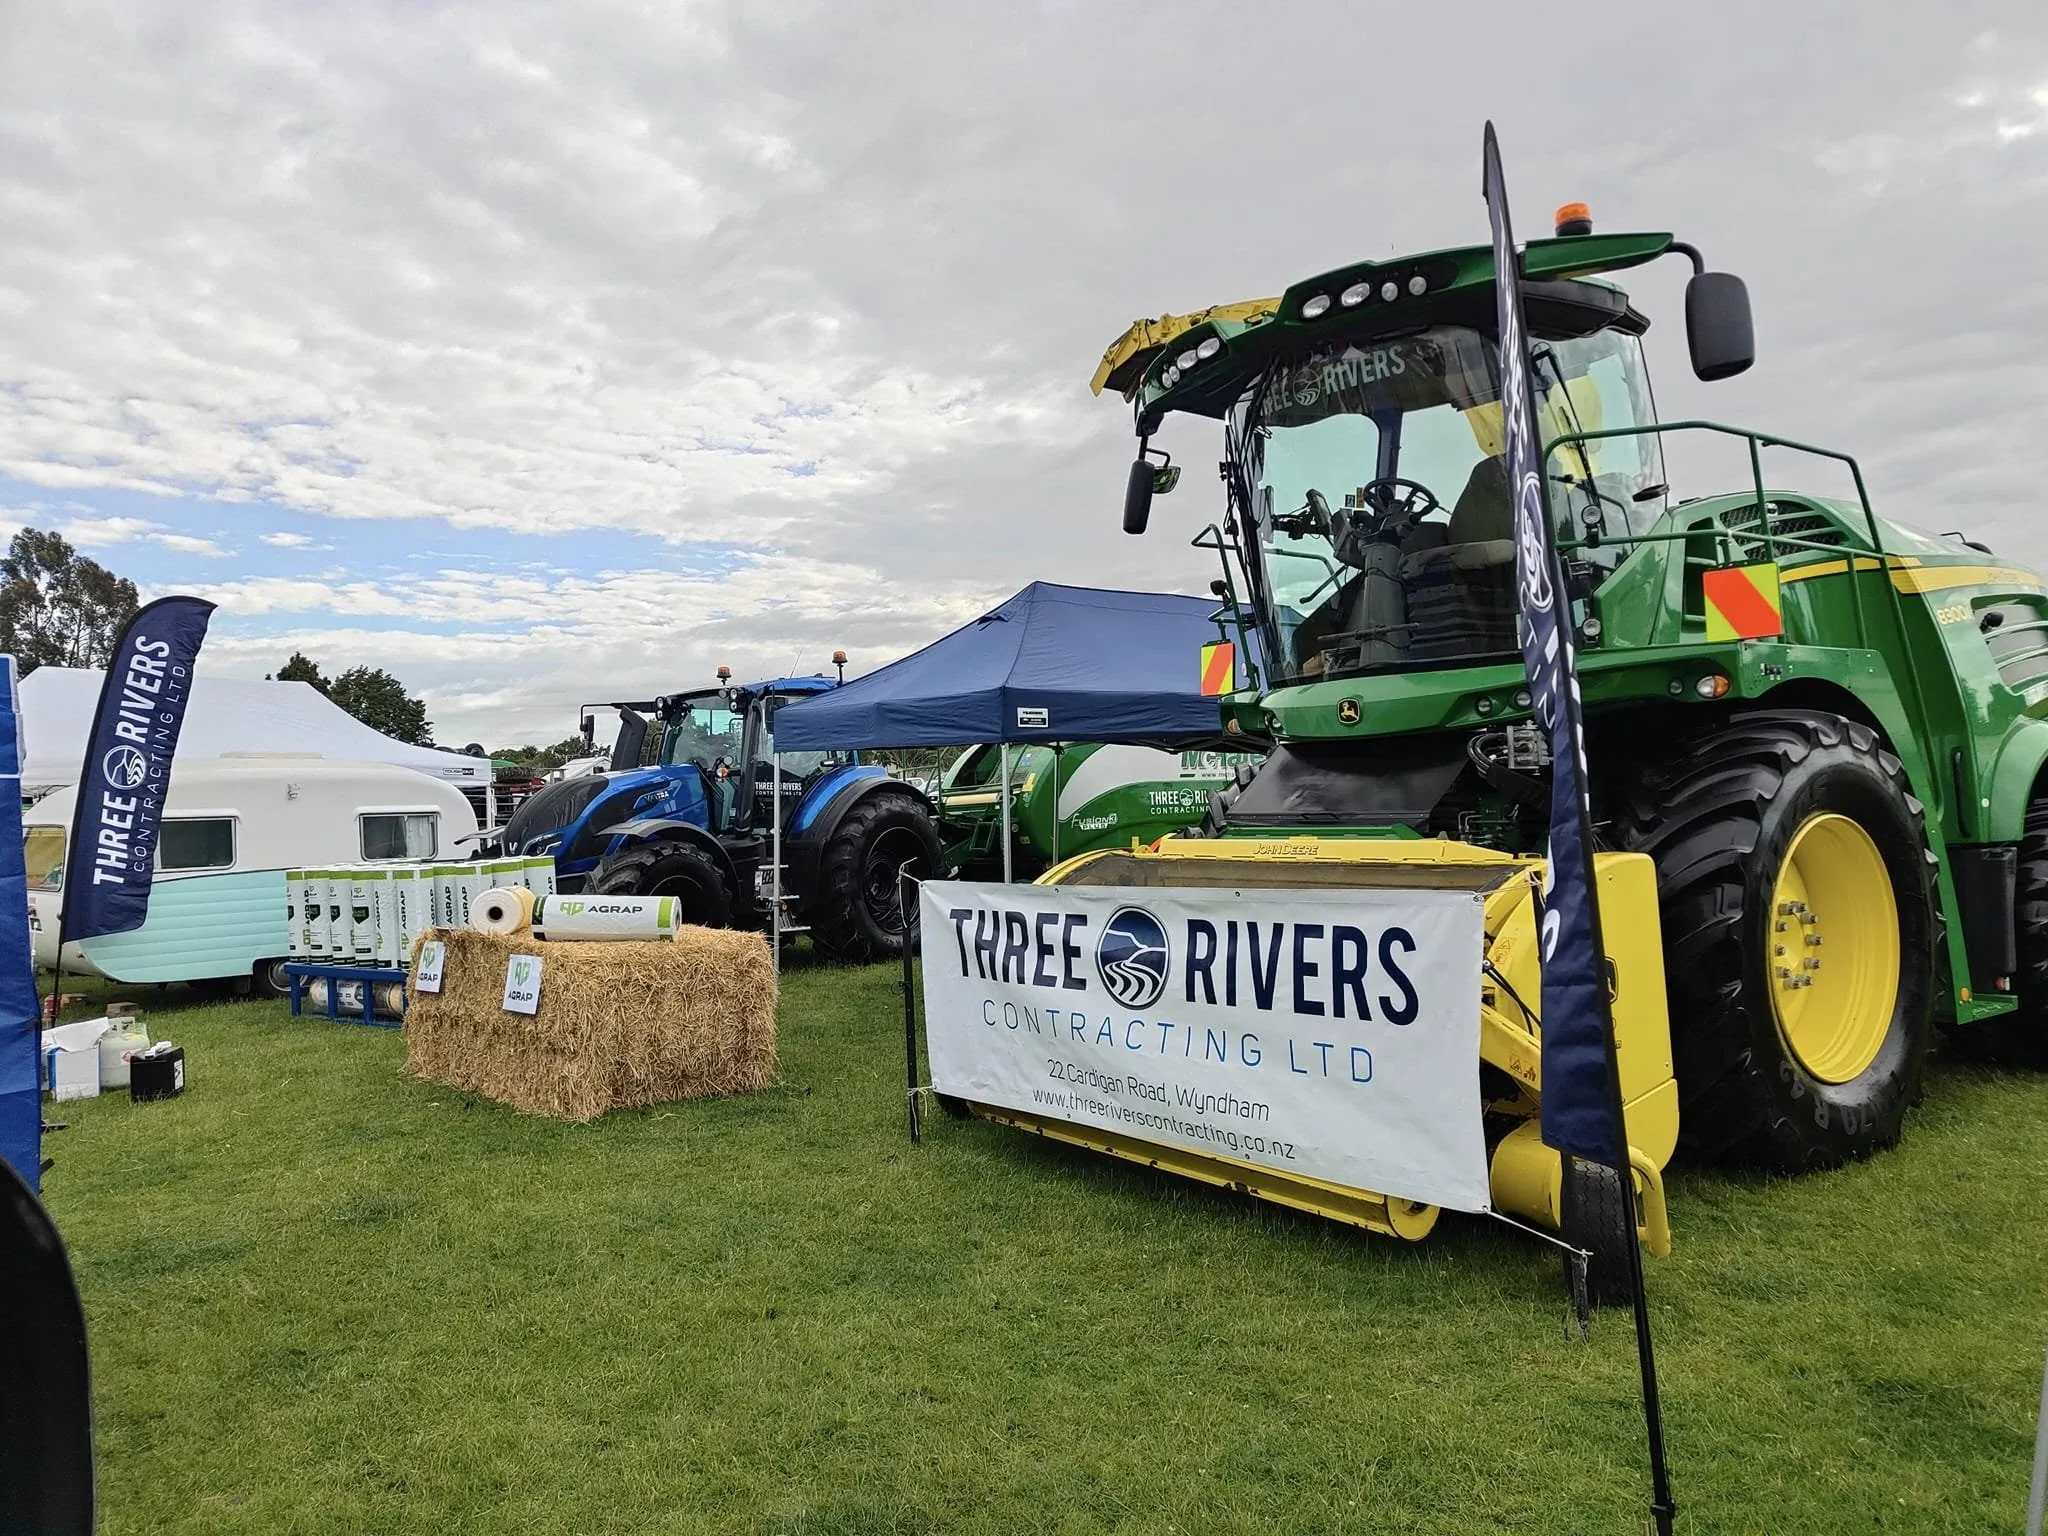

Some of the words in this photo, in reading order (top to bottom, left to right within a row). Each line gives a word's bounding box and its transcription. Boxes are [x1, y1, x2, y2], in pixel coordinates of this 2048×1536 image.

[1323, 345, 1405, 395] RIVERS
[92, 790, 137, 885] THREE
[115, 635, 170, 744] RIVERS
[133, 712, 174, 873] CONTRACTING
[165, 666, 186, 703] LTD
[755, 782, 774, 790] THREE
[1149, 790, 1179, 805] THREE
[1254, 842, 1282, 855] JOHN
[1282, 844, 1319, 856] DEERE
[445, 886, 453, 925] AGRAP
[462, 886, 470, 925] AGRAP
[587, 905, 643, 914] AGRAP
[949, 908, 1088, 991] THREE
[1185, 918, 1419, 1026] RIVERS
[507, 990, 534, 1002] AGRAP
[982, 999, 1262, 1067] CONTRACTING
[1289, 1039, 1374, 1084] LTD
[1047, 1059, 1066, 1080] 22
[1066, 1063, 1124, 1095] Cardigan
[1127, 1076, 1171, 1108] Road,
[1175, 1084, 1270, 1121] Wyndham
[1032, 1088, 1296, 1160] www.threeriverscontracting.co.nz
